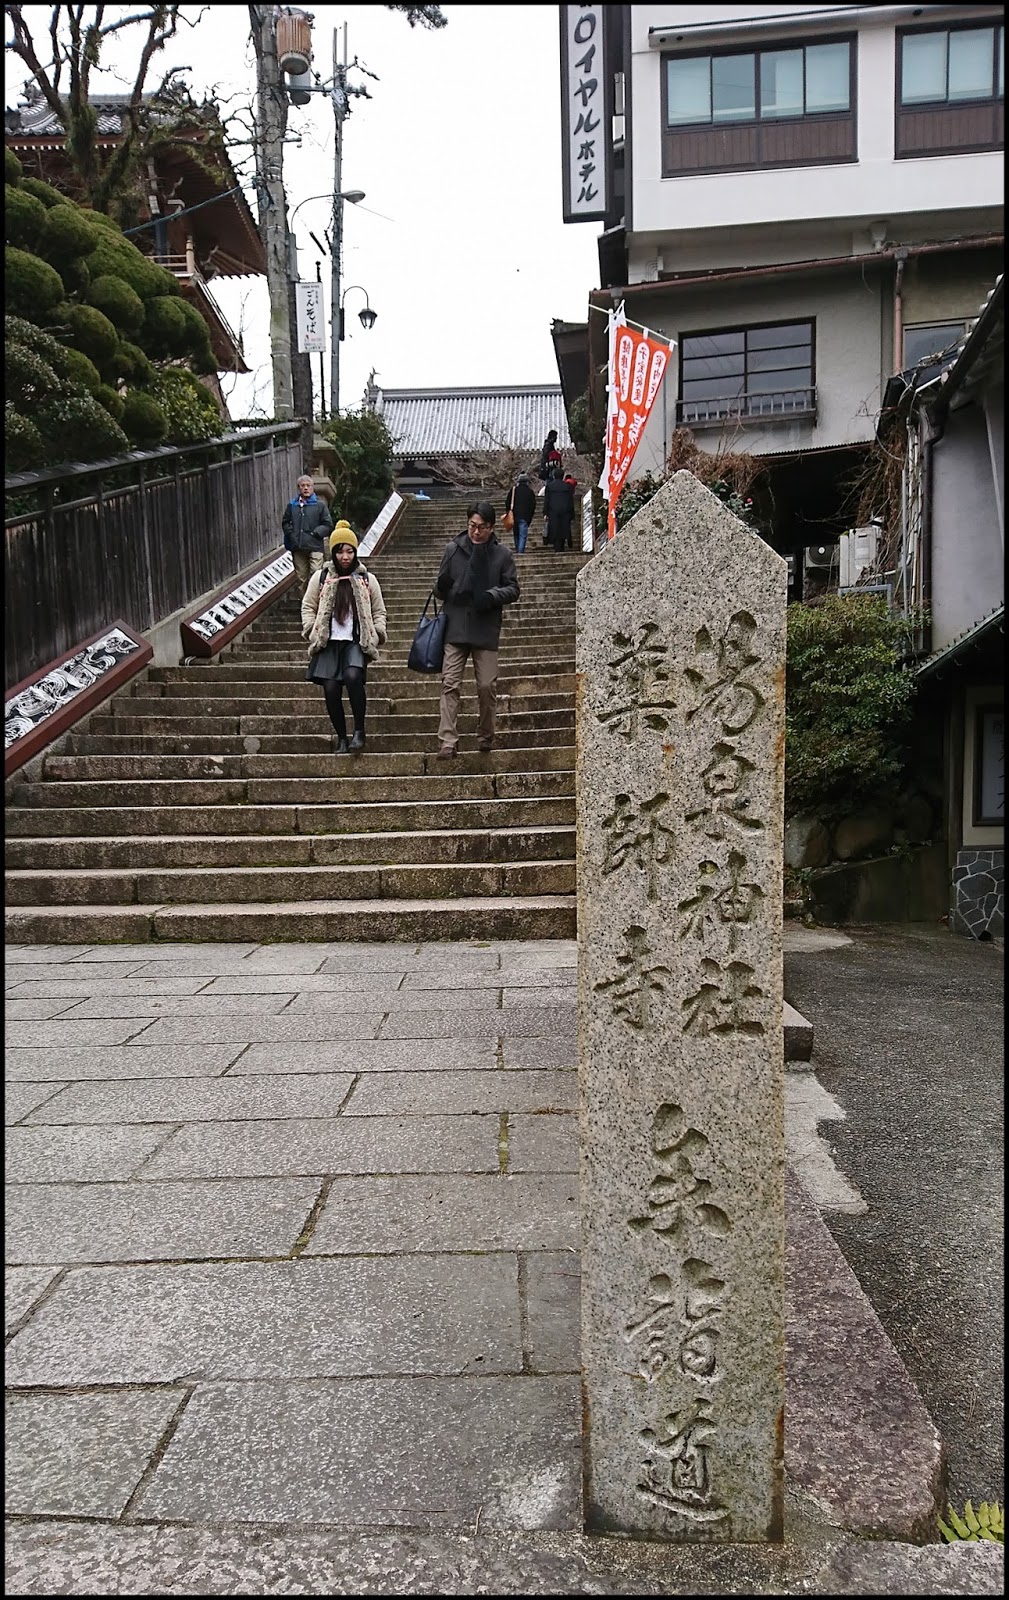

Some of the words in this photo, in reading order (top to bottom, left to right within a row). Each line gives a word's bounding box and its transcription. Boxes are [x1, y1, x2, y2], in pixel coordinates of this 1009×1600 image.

[574, 5, 600, 203] ロイヤルホテル
